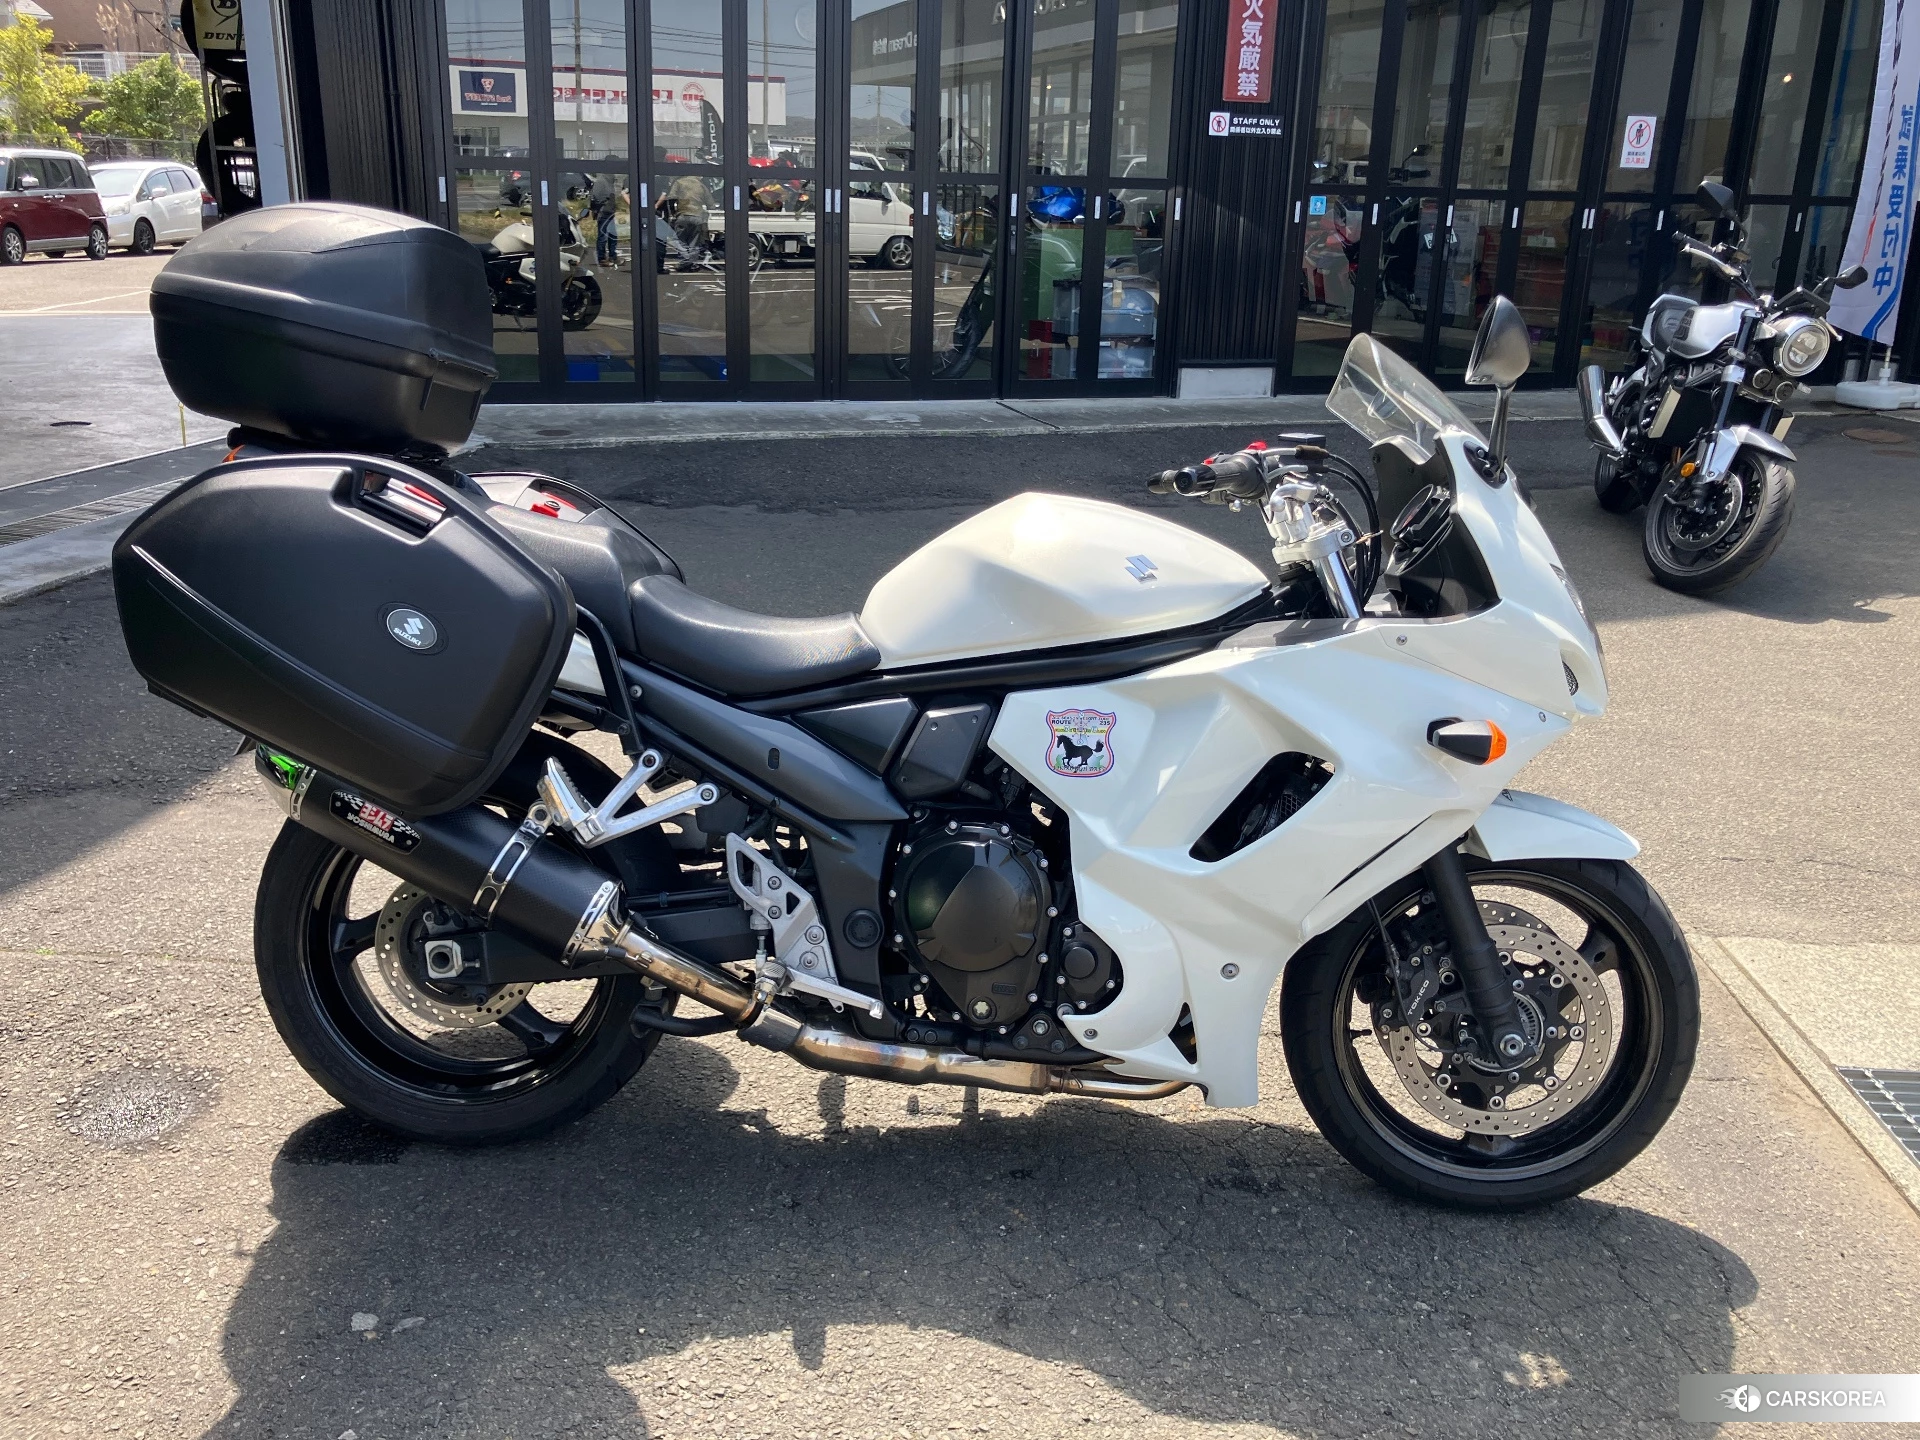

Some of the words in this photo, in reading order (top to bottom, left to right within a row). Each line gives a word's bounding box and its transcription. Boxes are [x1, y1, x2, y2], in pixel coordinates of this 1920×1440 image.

[1237, 0, 1263, 97] 火気厳禁
[1233, 117, 1258, 125] STAFF
[393, 627, 422, 646] SUZUKI
[346, 812, 395, 844] YOSHIMURA
[1407, 979, 1430, 1016] TOKICO
